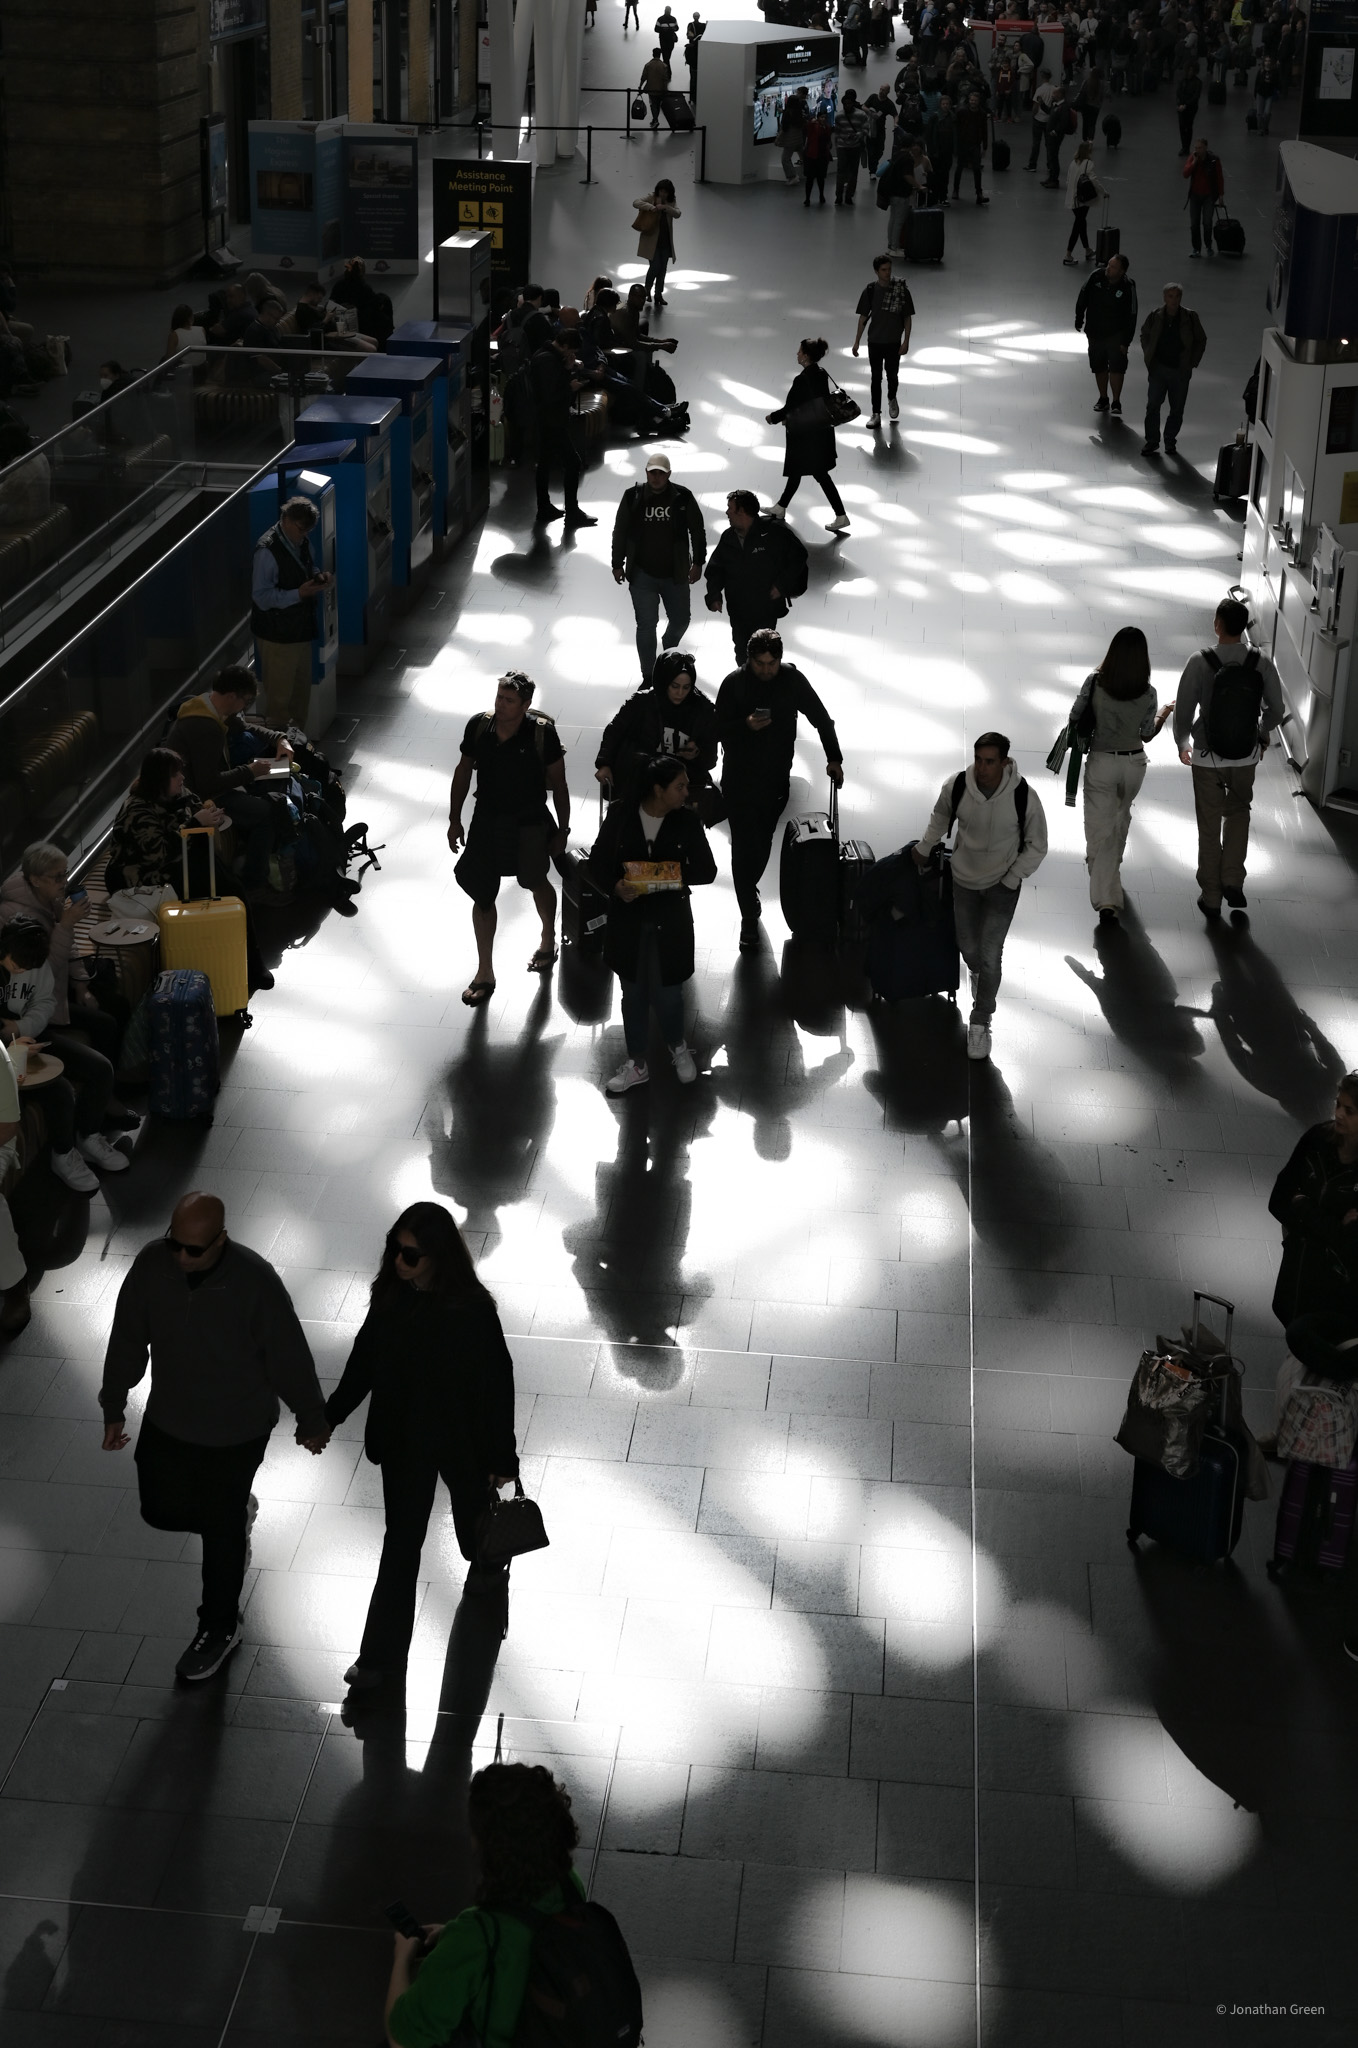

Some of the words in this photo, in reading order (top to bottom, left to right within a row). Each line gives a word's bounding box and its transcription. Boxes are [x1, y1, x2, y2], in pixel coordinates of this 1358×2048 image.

[456, 169, 506, 180] Assistance
[448, 180, 487, 193] Meeting
[489, 182, 514, 192] Point
